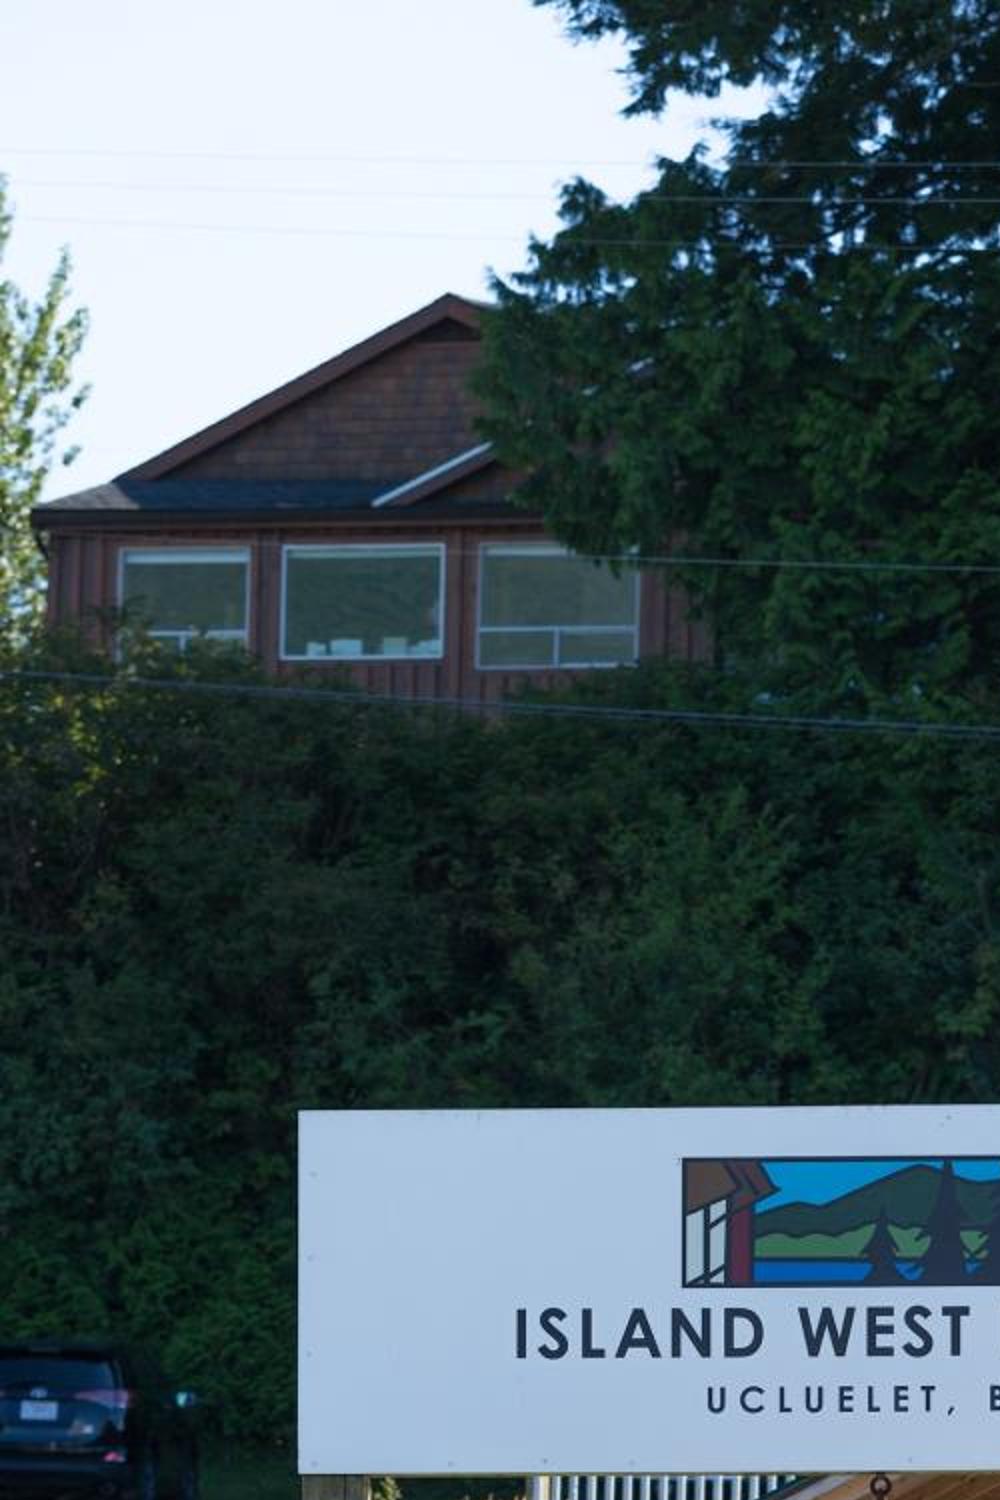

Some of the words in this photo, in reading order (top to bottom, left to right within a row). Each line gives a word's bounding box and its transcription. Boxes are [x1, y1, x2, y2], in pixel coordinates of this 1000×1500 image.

[516, 1307, 764, 1360] ISLAND
[797, 1305, 971, 1358] WEST
[707, 1385, 955, 1416] UCLUELET,
